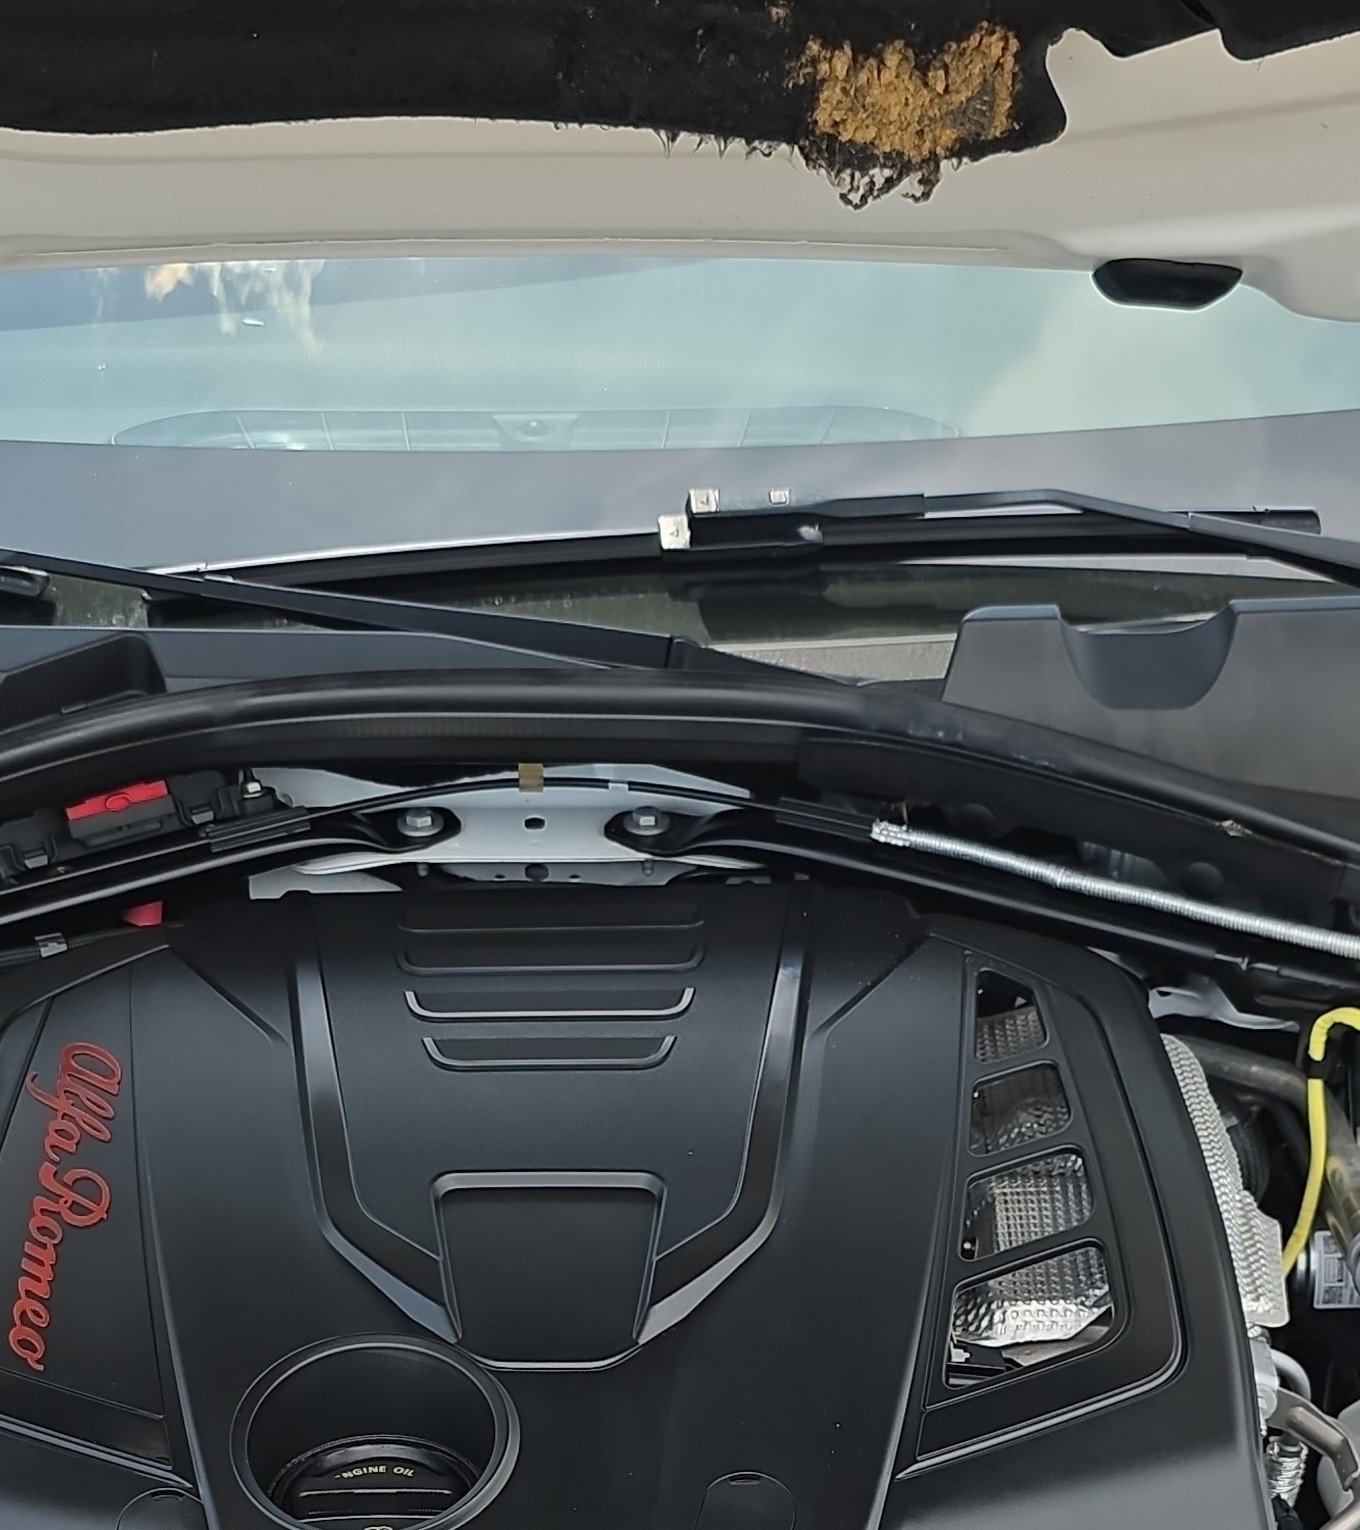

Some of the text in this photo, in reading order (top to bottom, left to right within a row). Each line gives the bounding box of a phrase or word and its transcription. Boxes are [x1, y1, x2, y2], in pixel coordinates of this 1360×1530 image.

[9, 1042, 122, 1371] Alfa Romeo
[392, 1466, 415, 1477] OIL
